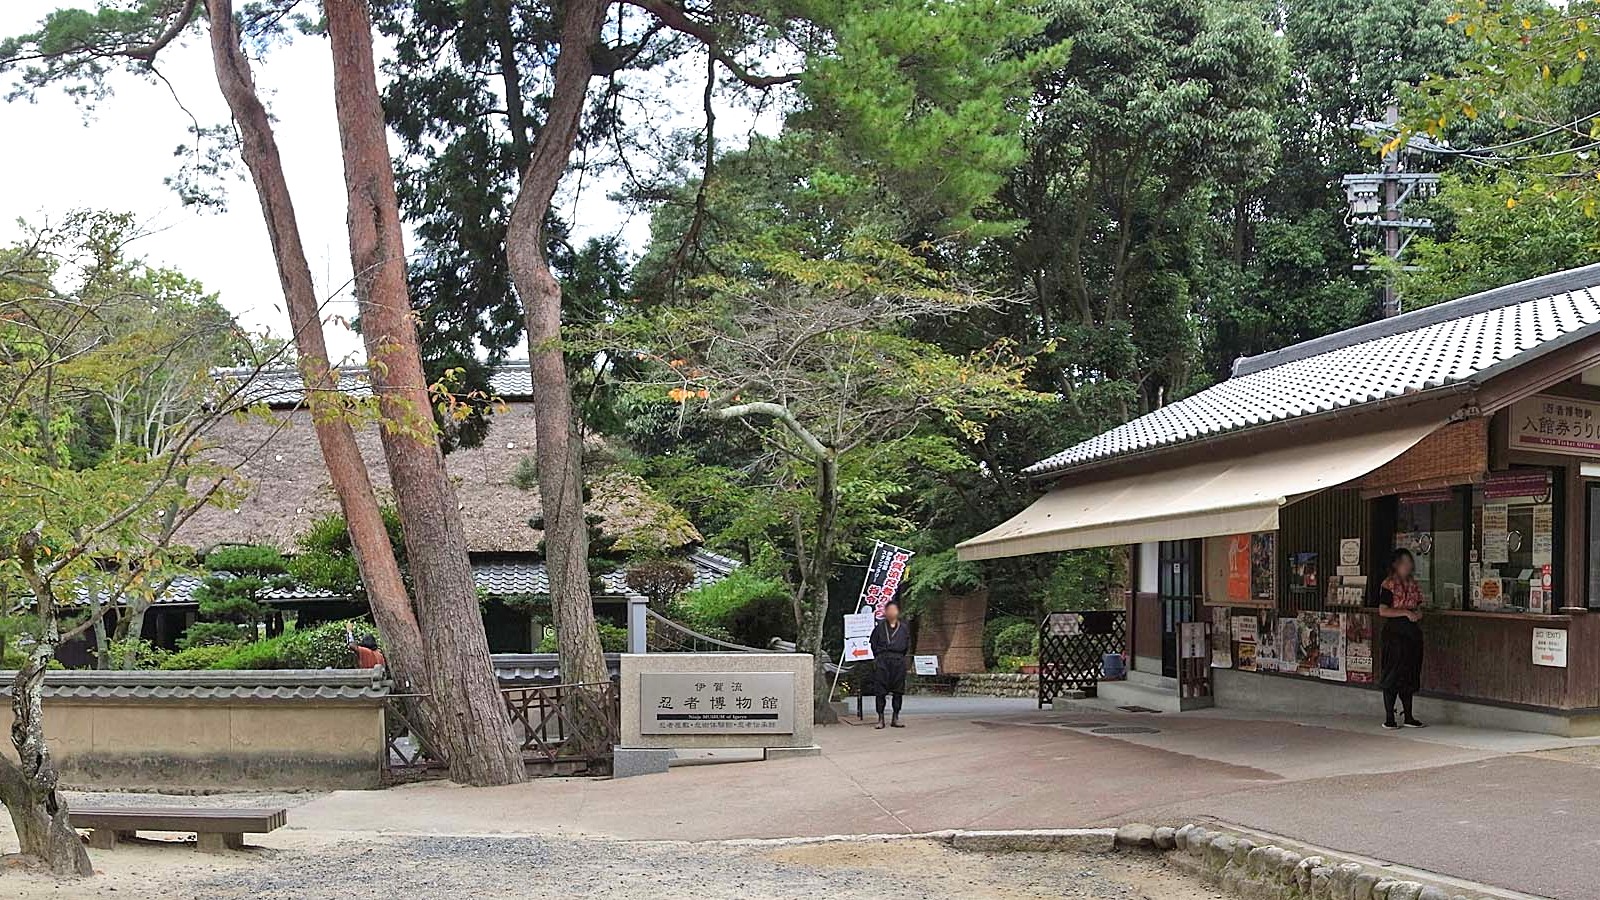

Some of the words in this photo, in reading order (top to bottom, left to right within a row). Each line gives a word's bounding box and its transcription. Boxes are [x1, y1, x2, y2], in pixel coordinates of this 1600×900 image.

[695, 682, 743, 692] 伊賀流
[658, 696, 778, 710] 忍者博物館
